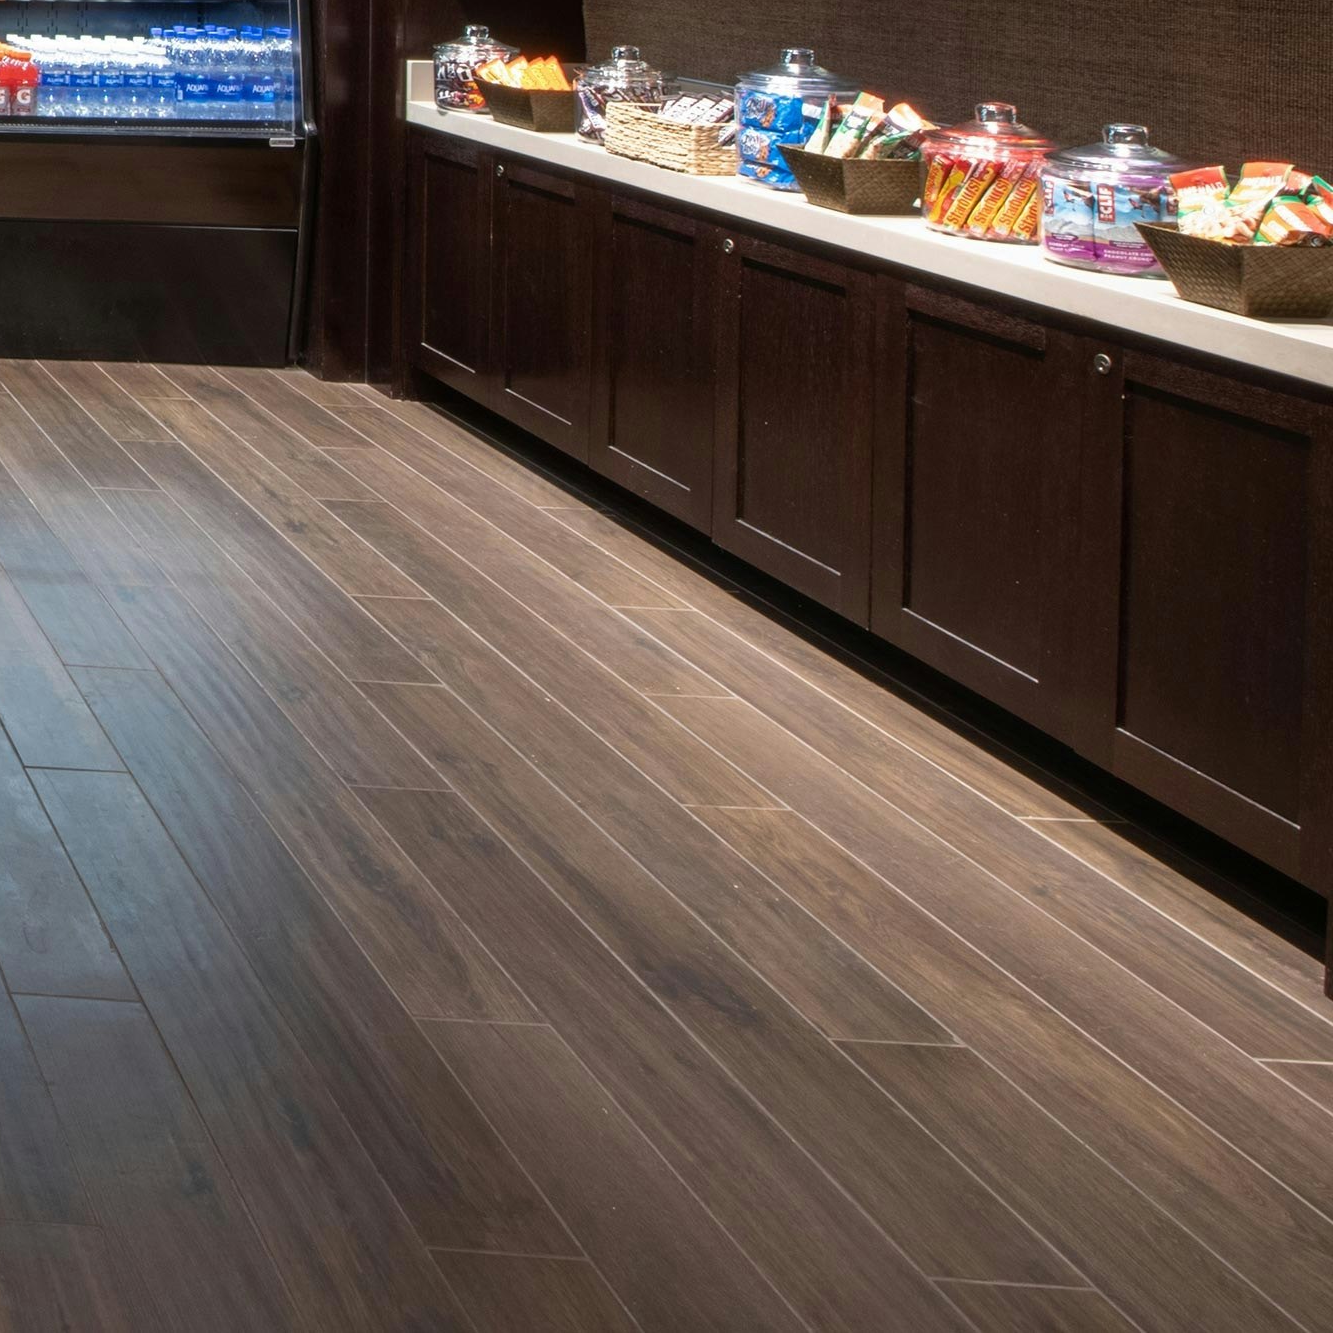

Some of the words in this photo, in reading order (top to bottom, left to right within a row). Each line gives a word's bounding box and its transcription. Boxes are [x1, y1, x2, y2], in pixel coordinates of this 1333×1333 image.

[17, 88, 31, 103] G
[946, 178, 982, 224] Starburst
[974, 178, 1009, 223] Starburst
[999, 179, 1032, 224] Starburst
[1101, 186, 1113, 210] CLIF
